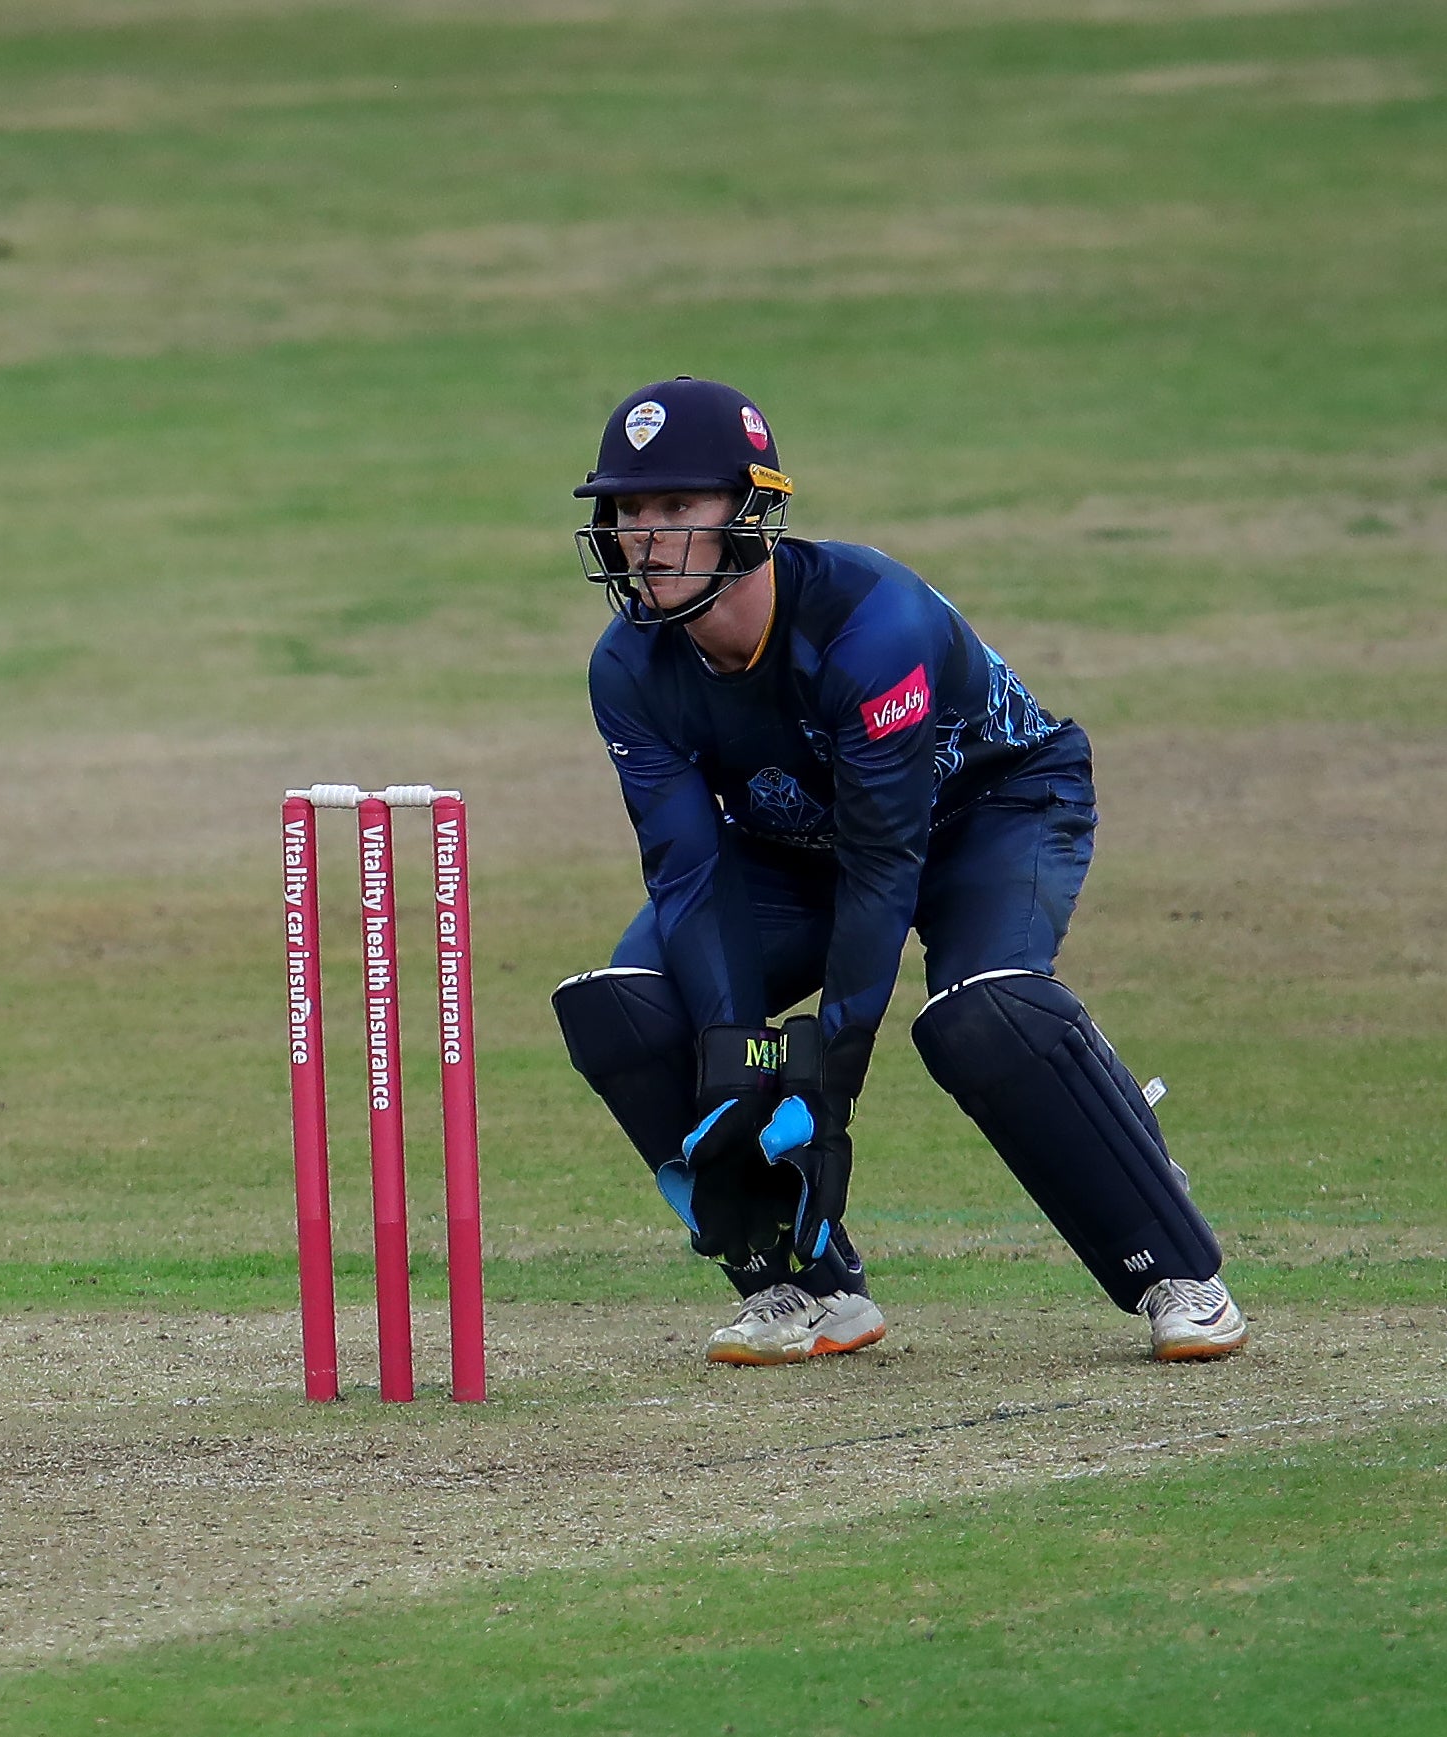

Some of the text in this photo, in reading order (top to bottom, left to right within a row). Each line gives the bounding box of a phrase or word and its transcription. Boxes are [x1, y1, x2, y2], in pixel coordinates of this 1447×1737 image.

[873, 686, 924, 728] Vitality
[284, 819, 310, 1065] Vitality car insurance
[362, 824, 391, 1110] Vitality health insurance
[436, 819, 463, 1065] Vitality car insurance
